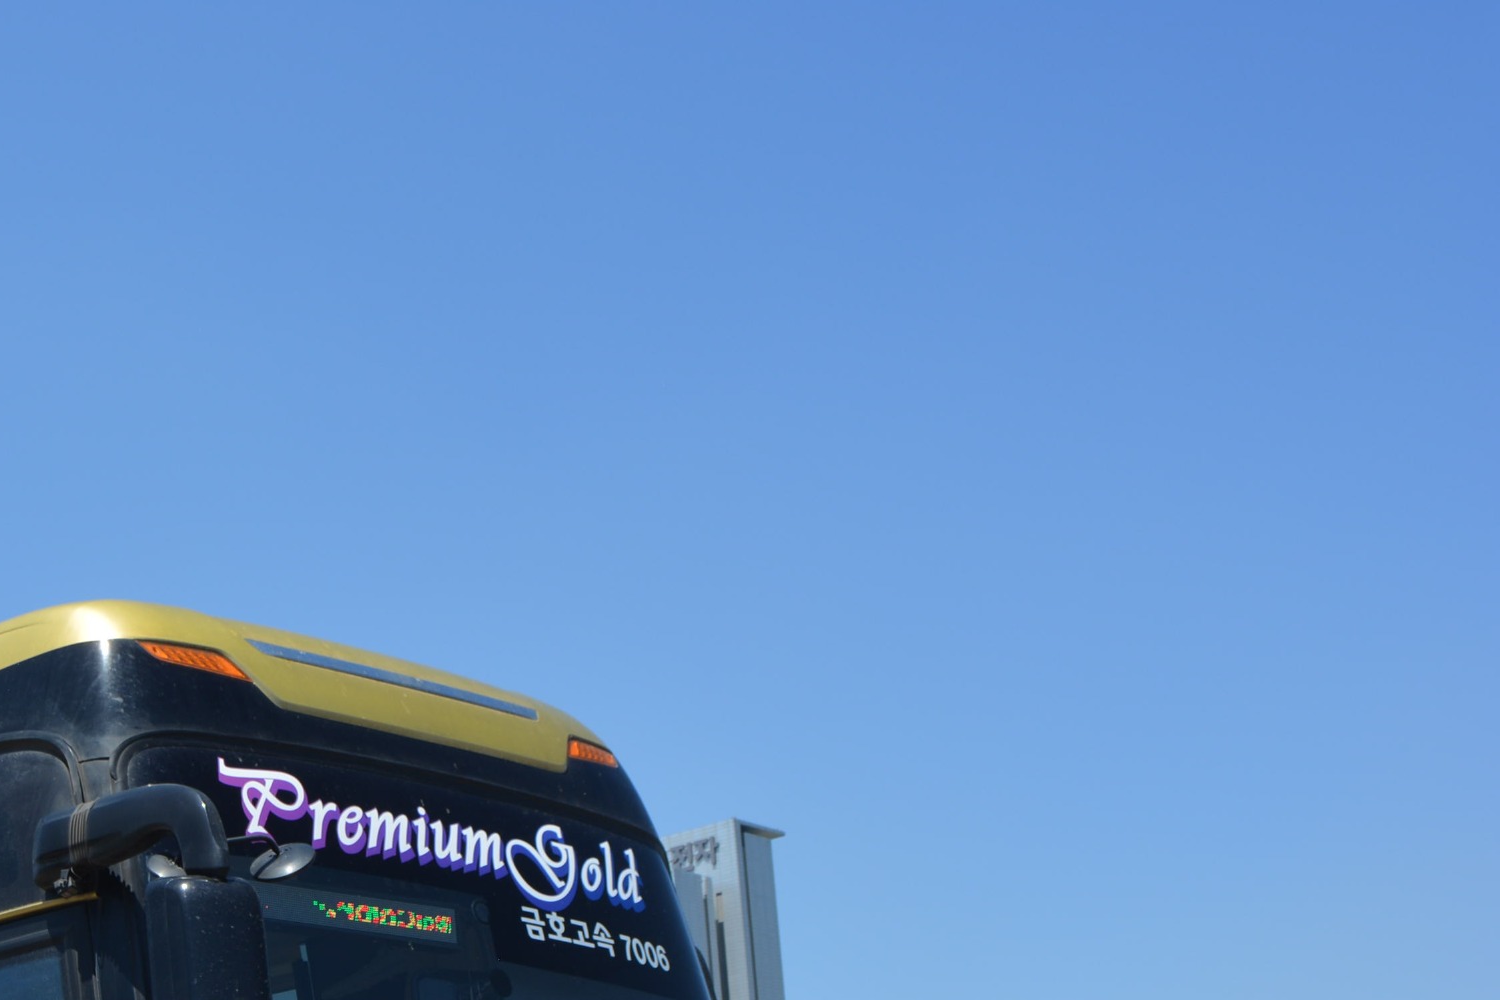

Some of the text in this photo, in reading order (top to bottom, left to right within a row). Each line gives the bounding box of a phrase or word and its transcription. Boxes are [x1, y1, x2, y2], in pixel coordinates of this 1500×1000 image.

[218, 757, 644, 909] Premium Gold
[520, 906, 670, 971] 금호고속 7006
